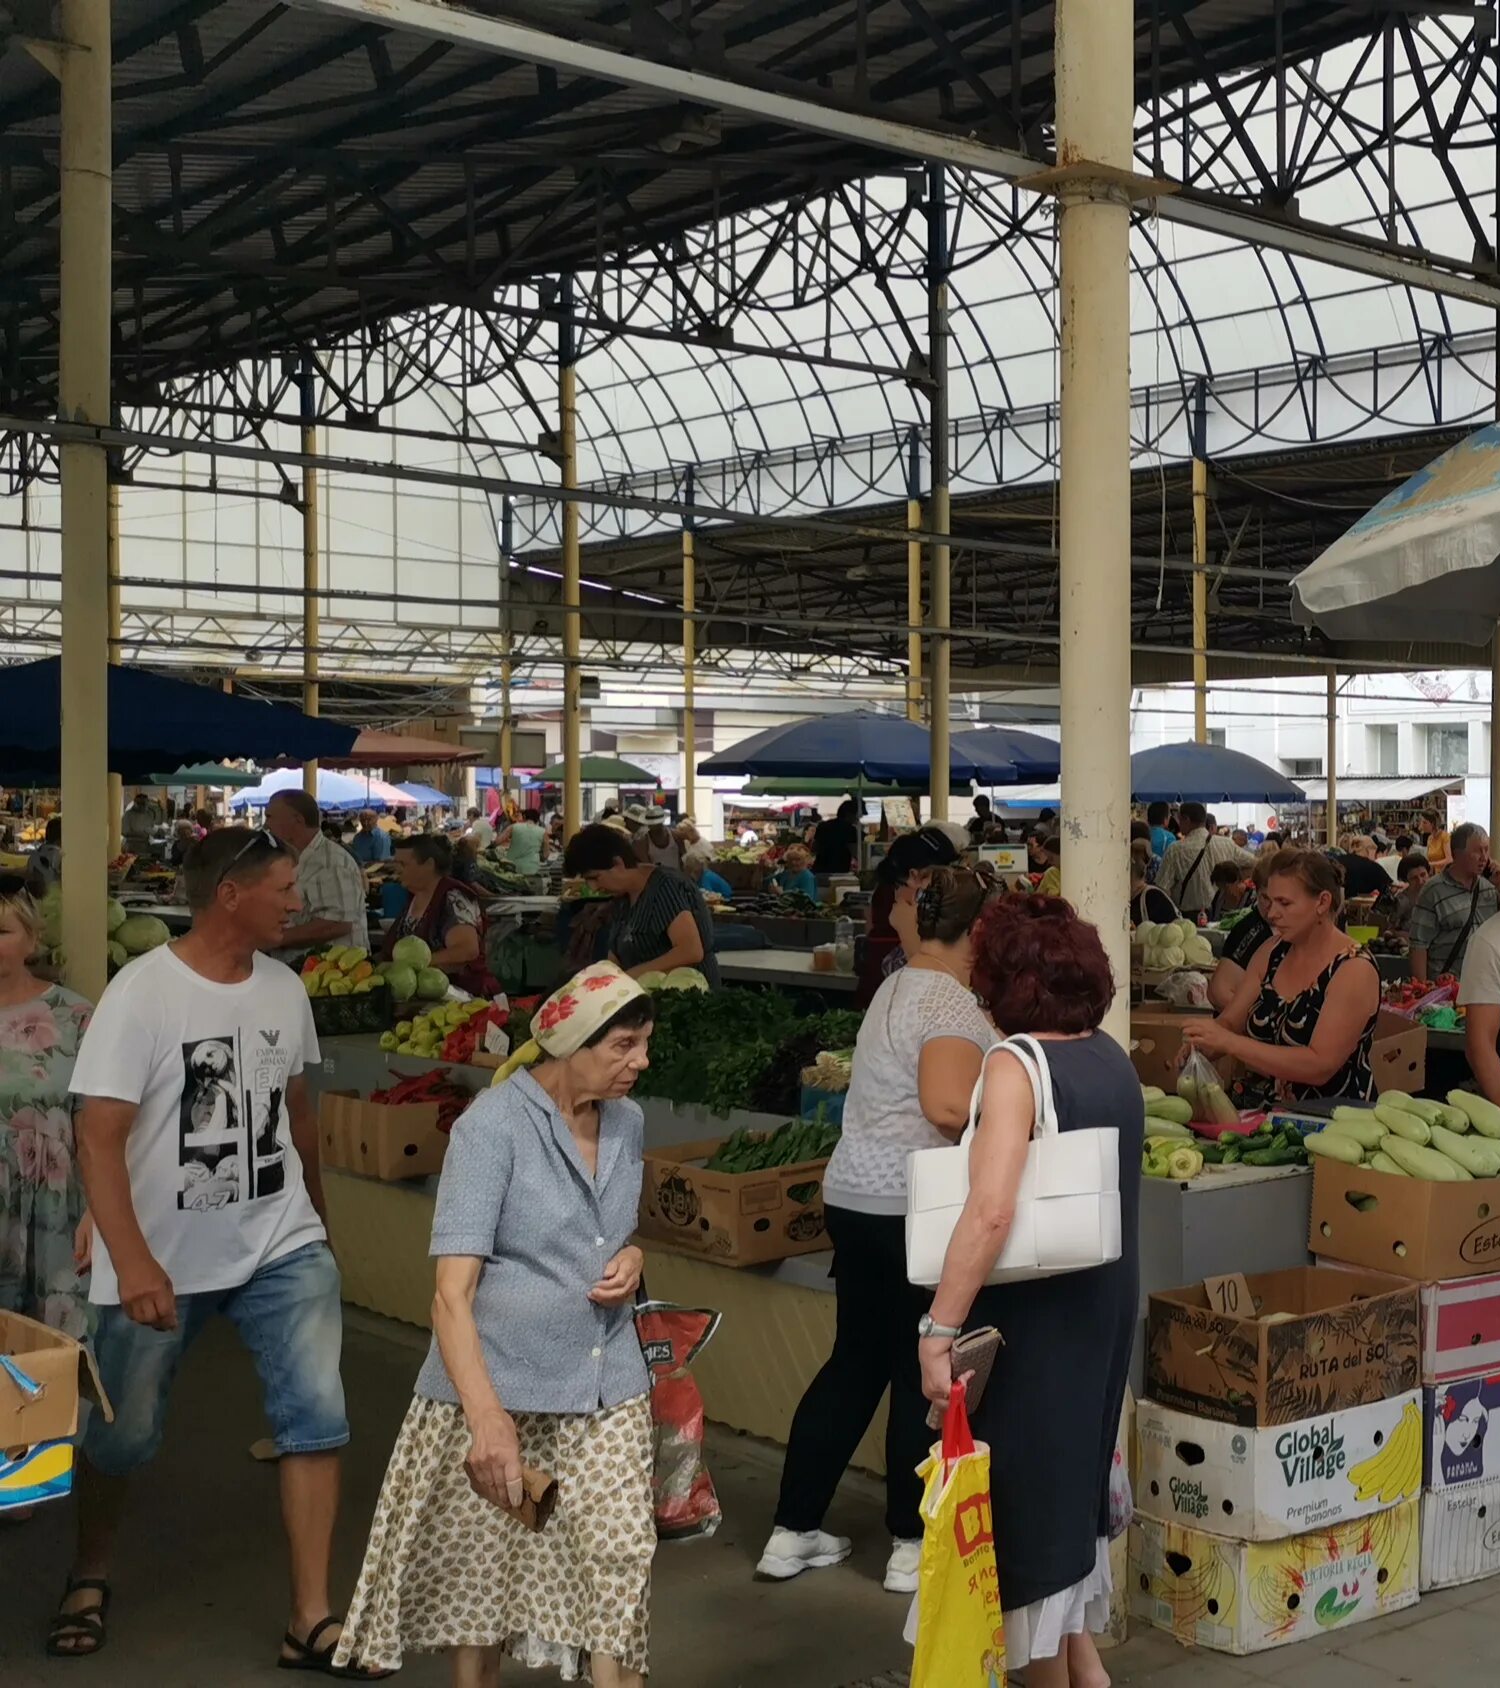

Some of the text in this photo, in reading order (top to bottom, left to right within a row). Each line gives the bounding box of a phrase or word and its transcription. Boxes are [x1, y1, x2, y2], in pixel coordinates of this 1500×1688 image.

[1216, 1279, 1239, 1313] 10
[1300, 1357, 1339, 1381] RUTA
[1343, 1352, 1362, 1369] del
[1275, 1418, 1337, 1460] Global
[1281, 1449, 1346, 1487] Village
[1169, 1476, 1203, 1496] Global
[1172, 1494, 1209, 1519] Village
[1287, 1499, 1329, 1519] Premium
[1305, 1504, 1343, 1525] bananas
[1447, 1496, 1477, 1512] Estelar
